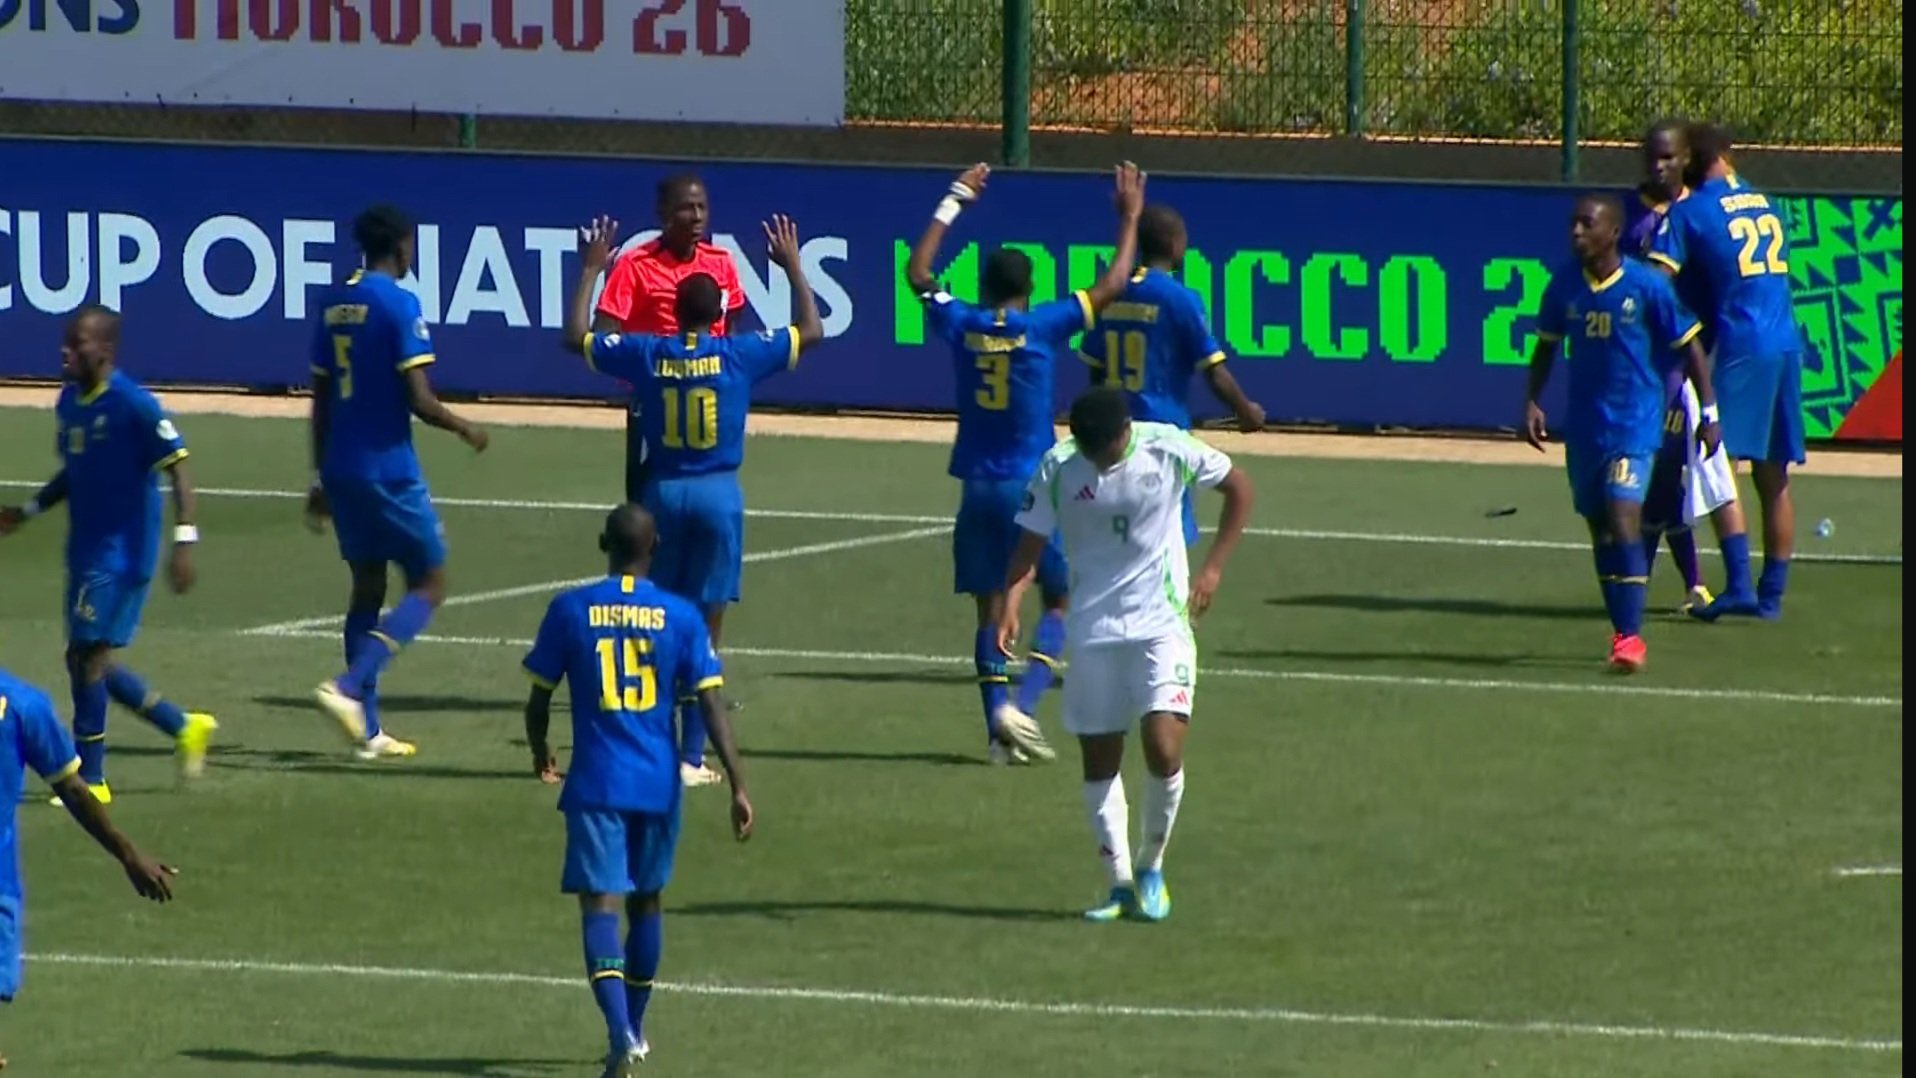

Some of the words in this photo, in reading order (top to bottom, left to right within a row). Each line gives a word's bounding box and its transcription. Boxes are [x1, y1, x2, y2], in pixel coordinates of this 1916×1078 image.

[633, 0, 751, 57] 26
[1728, 213, 1788, 277] 22
[0, 206, 161, 315] UP
[183, 215, 335, 320] OF
[360, 224, 852, 338] ATNS
[1483, 258, 1569, 365] 2
[1585, 311, 1612, 338] 20
[332, 335, 352, 399] 5
[975, 354, 1009, 411] 3
[1104, 330, 1147, 393] 19
[662, 387, 718, 450] 10
[1113, 515, 1129, 542] 9
[589, 605, 665, 630] DISMAS
[596, 638, 656, 712] 15
